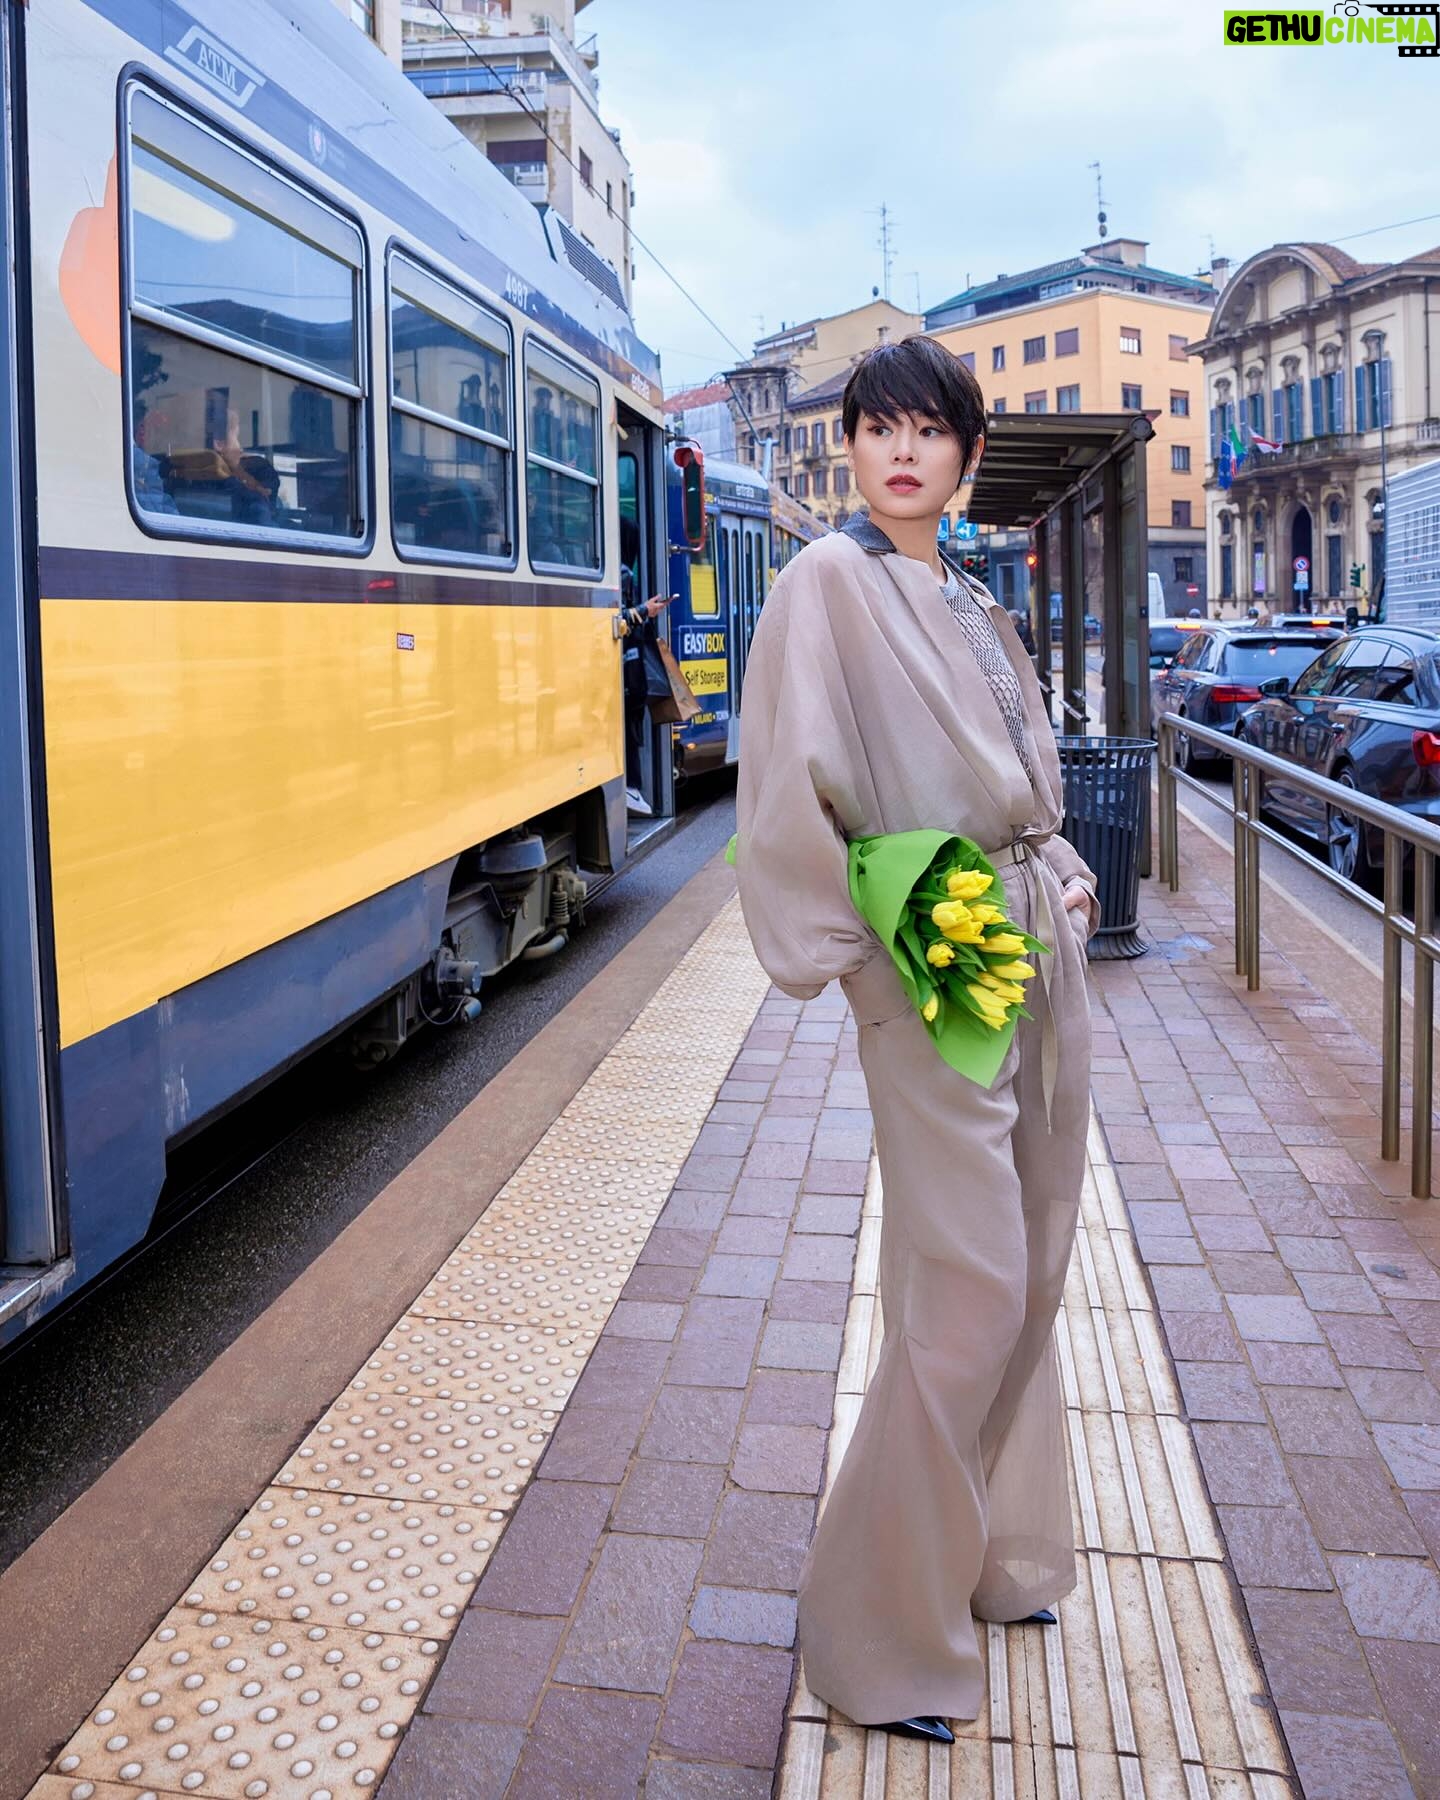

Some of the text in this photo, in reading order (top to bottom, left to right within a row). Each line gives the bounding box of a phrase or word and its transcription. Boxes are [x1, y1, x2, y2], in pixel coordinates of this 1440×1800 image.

[197, 43, 238, 92] ATM
[505, 271, 528, 311] 4987
[684, 633, 725, 654] EASYBOX
[685, 670, 725, 687] Self Storage
